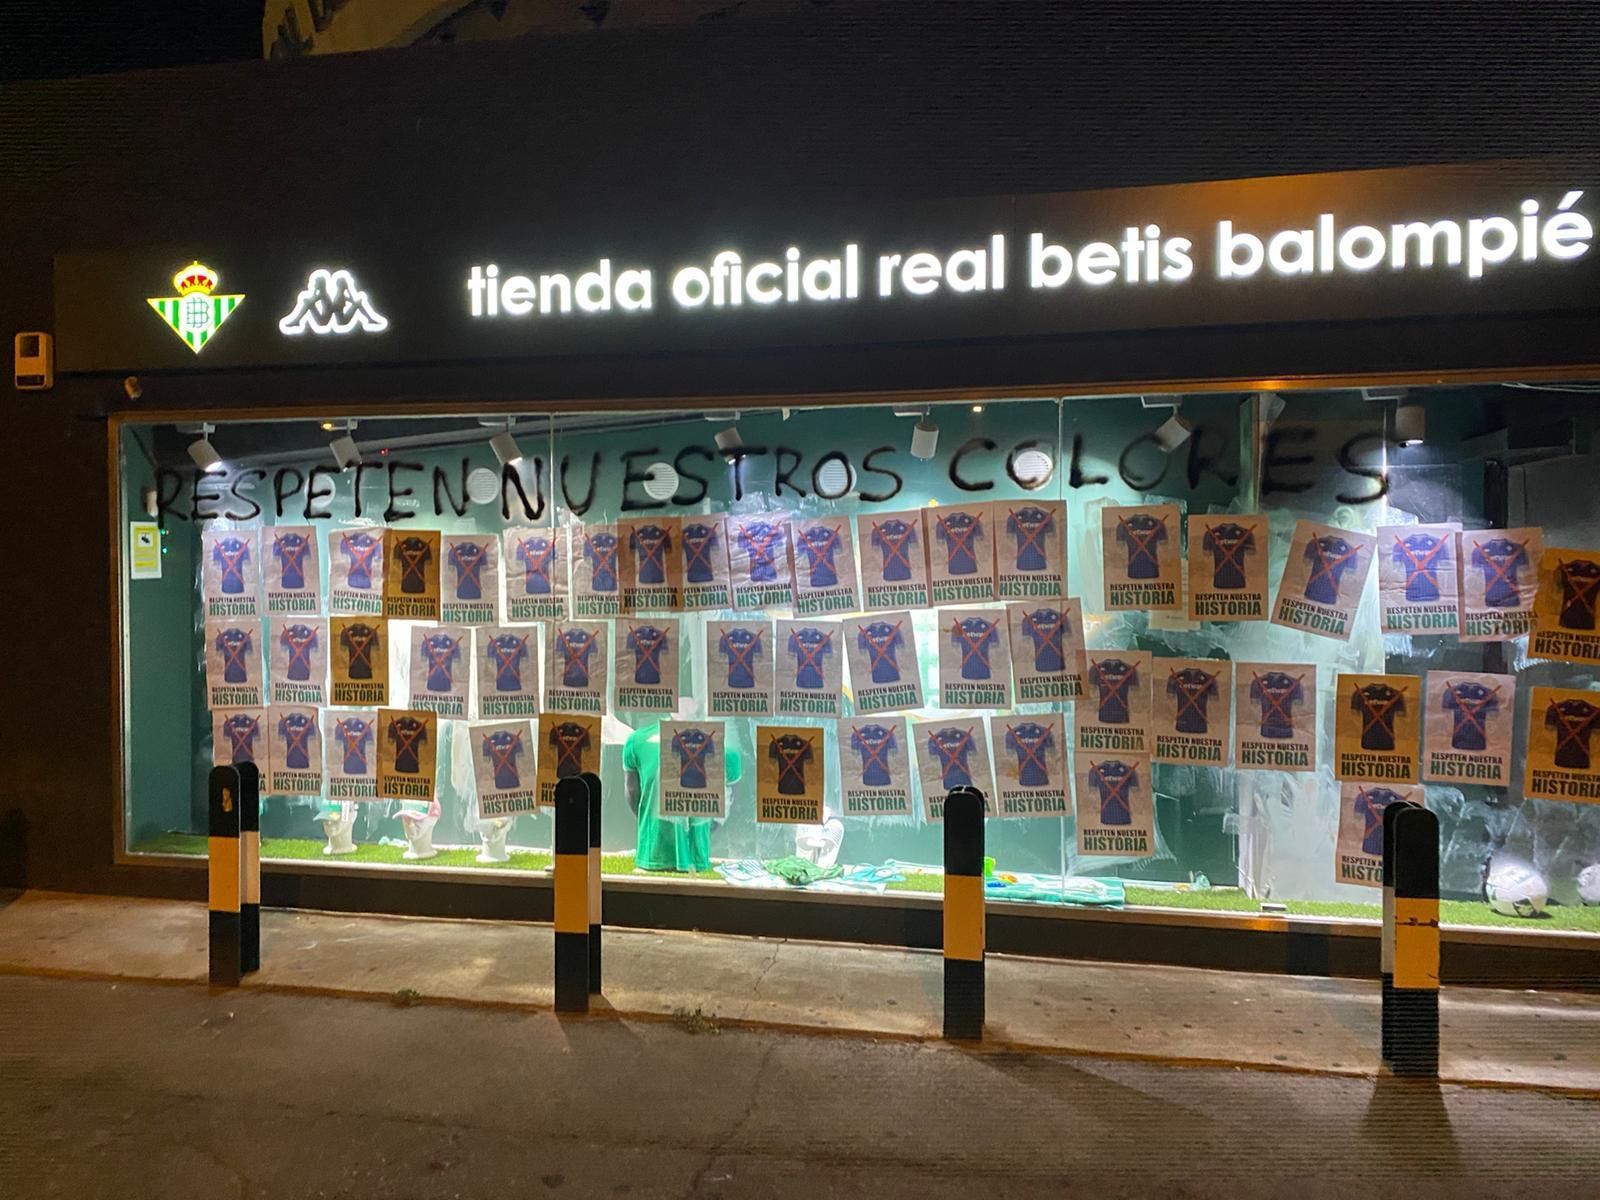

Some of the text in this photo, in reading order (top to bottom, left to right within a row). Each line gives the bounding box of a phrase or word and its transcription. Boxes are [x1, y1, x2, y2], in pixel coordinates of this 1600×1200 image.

[467, 190, 1594, 317] tienda oficial real betis balompié
[156, 428, 1390, 525] RESPETEN NUESTROS COLORES
[964, 577, 992, 585] NUESTRA
[827, 588, 852, 596] NUESTRA
[933, 584, 993, 600] HISTORIA
[1000, 582, 1061, 595] HISTORIA
[624, 595, 677, 607] HISTORIA
[736, 591, 792, 607] HISTORIA
[869, 592, 927, 606] HISTORIA
[1110, 591, 1175, 605] HISTORIA
[209, 604, 255, 616] HISTORIA
[269, 600, 316, 610] HISTORIA
[388, 604, 435, 616] HISTORIA
[512, 605, 563, 617] HISTORIA
[1196, 601, 1261, 615] HISTORIA
[1283, 599, 1348, 620] RESPETEN NUESTRA
[443, 610, 493, 622] HISTORIA
[1279, 606, 1344, 634] HISTORIA
[1387, 614, 1457, 629] HISTORIA
[1020, 674, 1082, 684] RESPETEN NUESTRA
[275, 690, 322, 702] HISTORIA
[335, 689, 384, 701] HISTORIA
[858, 684, 916, 696] RESPETEN NUESTRA
[1020, 681, 1083, 698] HISTORIA
[212, 693, 258, 704] HISTORIA
[549, 697, 600, 711] HISTORIA
[620, 695, 672, 708] HISTORIA
[859, 692, 917, 710] HISTORIA
[945, 691, 1005, 704] HISTORIA
[483, 702, 534, 715] HISTORIA
[713, 699, 768, 712] HISTORIA
[780, 699, 836, 713] HISTORIA
[1080, 735, 1144, 750] HISTORIA
[1157, 736, 1222, 746] RESPETEN NUESTRA
[1242, 742, 1275, 750] RESPETEN
[1157, 744, 1221, 760] HISTORIA
[1242, 750, 1308, 766] HISTORIA
[1431, 752, 1502, 764] RESPETEN NUESTRA
[1378, 755, 1410, 763] NUESTRA
[1342, 761, 1410, 778] HISTORIA
[1431, 761, 1500, 779] HISTORIA
[1533, 770, 1569, 779] RESPETEN
[273, 779, 320, 791] HISTORIA
[483, 793, 508, 801] RESPETEN
[848, 797, 906, 810] HISTORIA
[484, 798, 534, 814] HISTORIA
[665, 799, 718, 814] HISTORIA
[1004, 798, 1065, 812] HISTORIA
[763, 805, 817, 820] HISTORIA
[1084, 837, 1147, 851] HISTORIA
[1342, 856, 1378, 865] RESPETEN
